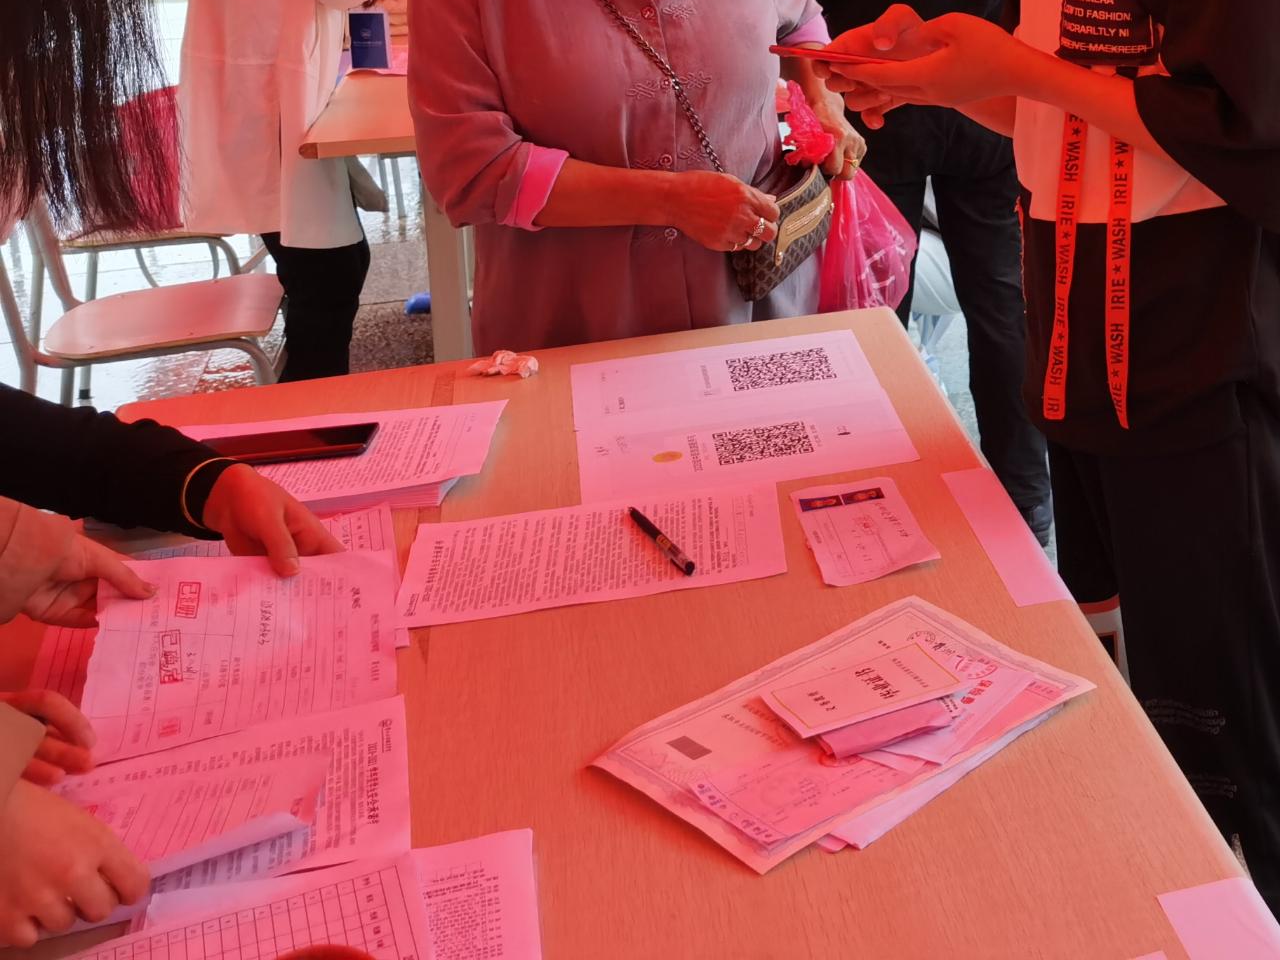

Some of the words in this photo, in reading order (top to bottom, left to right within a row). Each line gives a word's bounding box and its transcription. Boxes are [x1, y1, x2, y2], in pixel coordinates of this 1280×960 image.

[1063, 140, 1081, 182] WASH
[1113, 172, 1128, 205] IRIE
[1059, 193, 1076, 226] IRIE
[1112, 217, 1127, 261] WASH
[1057, 243, 1071, 285] WASH
[1055, 296, 1066, 329] IRIE
[1110, 277, 1126, 311] IRIE
[1110, 322, 1125, 365] WASH
[1050, 345, 1065, 386] WASH
[855, 667, 900, 700] 毕业证书
